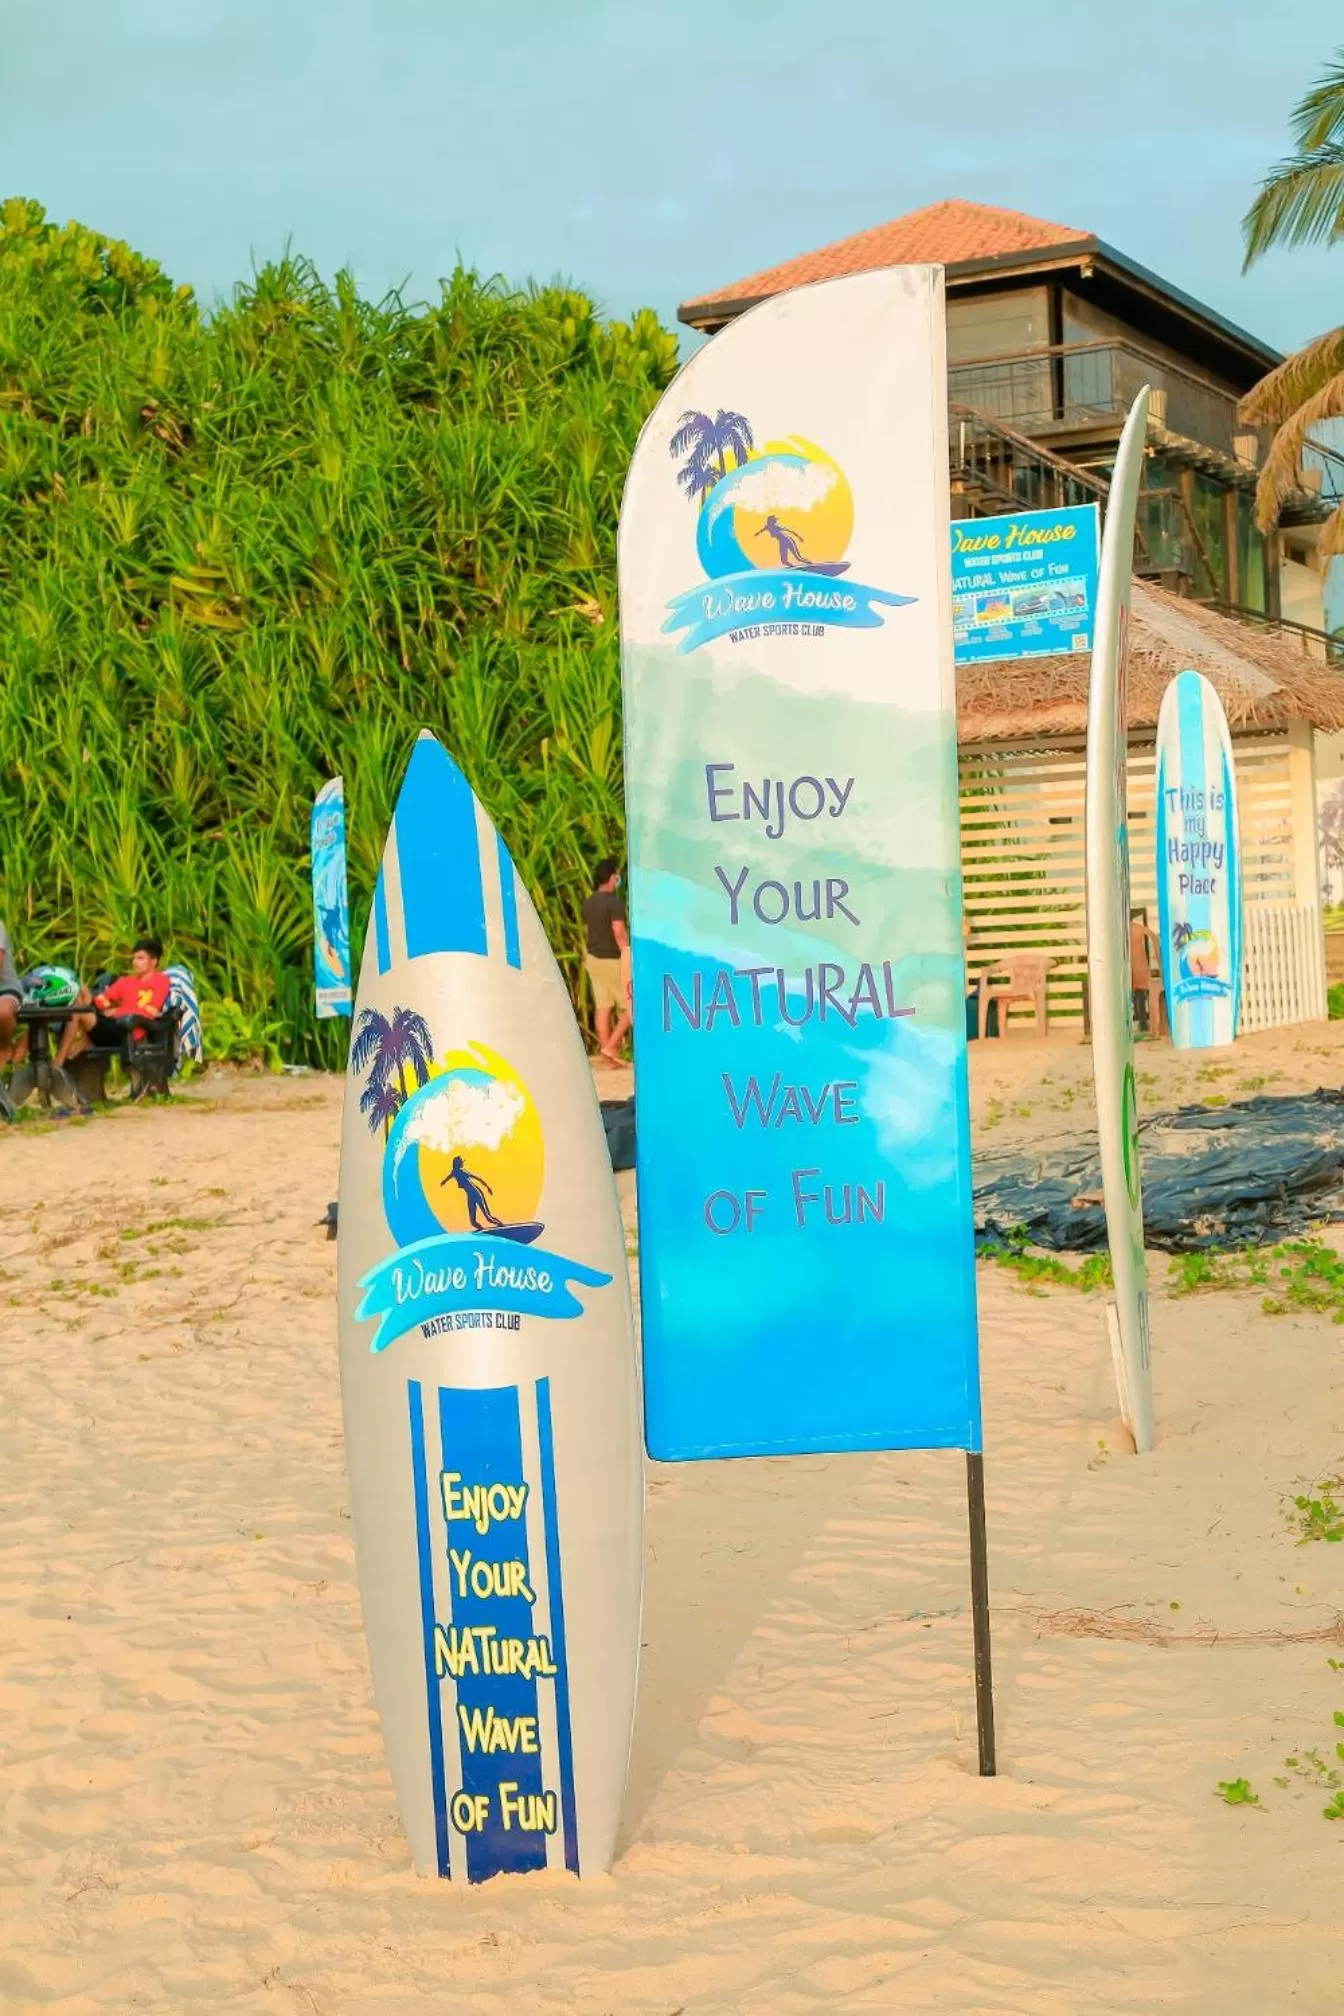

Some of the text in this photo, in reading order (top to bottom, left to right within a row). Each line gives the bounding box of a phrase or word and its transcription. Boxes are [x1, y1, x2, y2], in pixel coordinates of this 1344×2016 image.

[1005, 524, 1077, 549] House
[1022, 549, 1044, 561] CLUB
[1030, 567, 1045, 579] OF
[702, 581, 857, 620] Wave House
[729, 623, 825, 644] WATER SPORTS CLUB
[705, 763, 855, 839] ENJOY
[1165, 785, 1225, 813] This is
[1184, 816, 1205, 838] my
[1168, 837, 1224, 869] Happy
[714, 866, 860, 926] YOUR
[1178, 873, 1216, 895] Place
[662, 960, 916, 1032] NATURAL
[720, 1071, 861, 1130] WAVE
[703, 1168, 886, 1235] OF FUN
[391, 1251, 553, 1305] Wave House
[420, 1312, 521, 1339] WATER SPORTS CLUB
[442, 1472, 527, 1535] ENJOY
[449, 1548, 535, 1603] YOUR
[434, 1626, 558, 1680] NATURAL
[458, 1704, 539, 1754] WAVE
[453, 1781, 555, 1833] OF FUN
